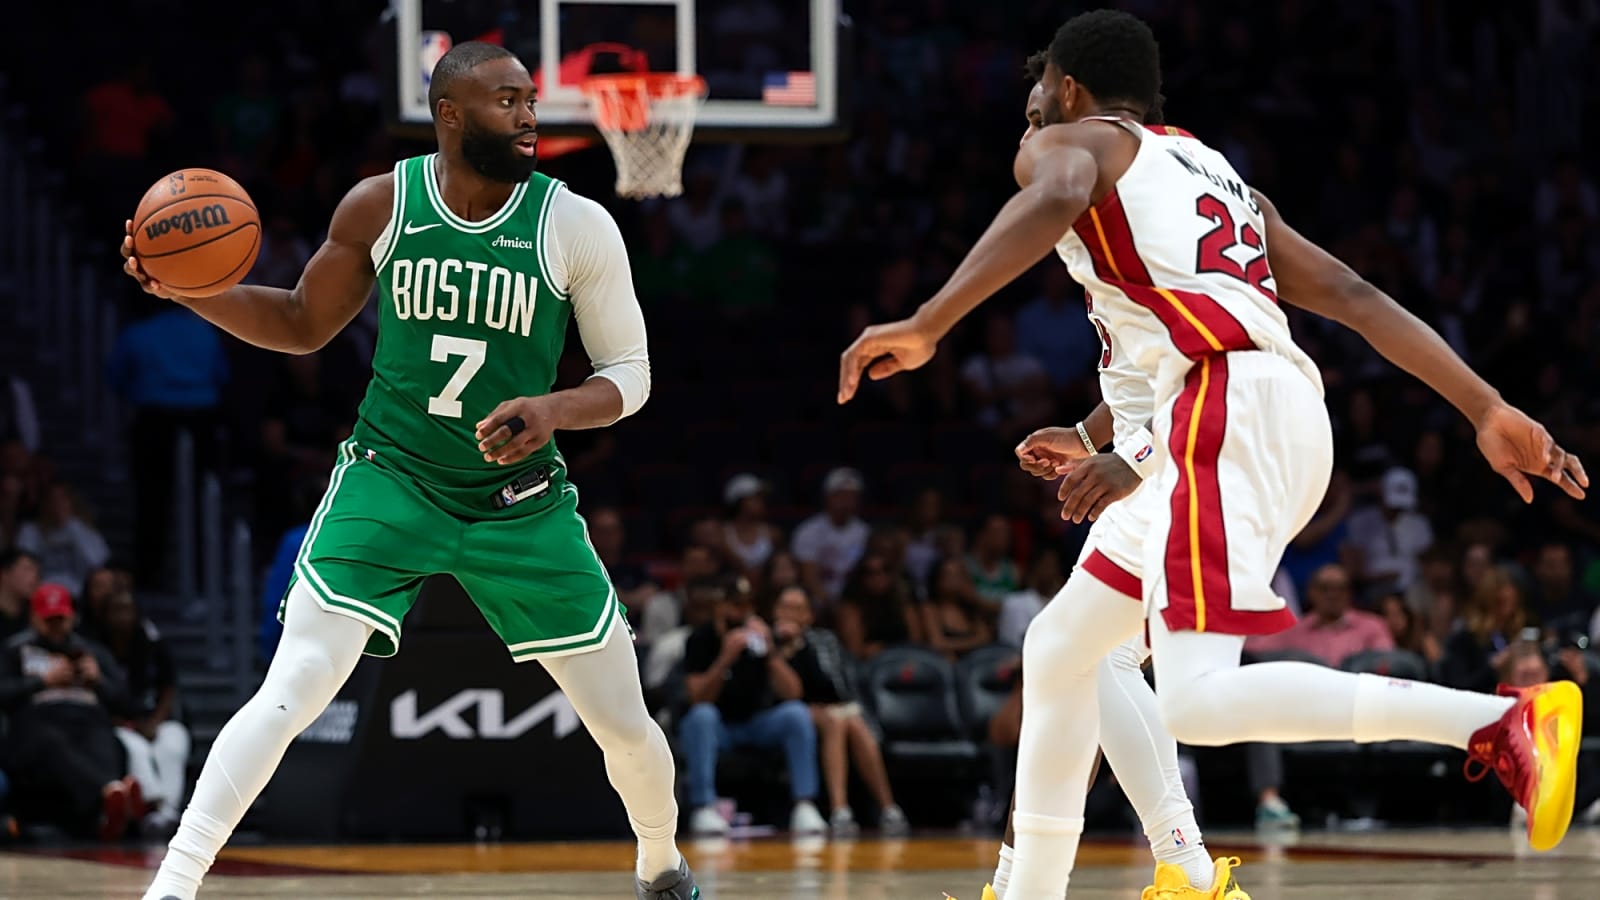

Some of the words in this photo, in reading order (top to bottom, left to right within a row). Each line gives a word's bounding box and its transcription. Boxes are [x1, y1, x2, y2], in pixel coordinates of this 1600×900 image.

[145, 204, 231, 240] Wilson
[491, 234, 533, 250] Amica
[1195, 192, 1278, 305] 22
[391, 257, 539, 337] BOSTON
[427, 333, 488, 419] 7
[390, 688, 581, 739] KIA
